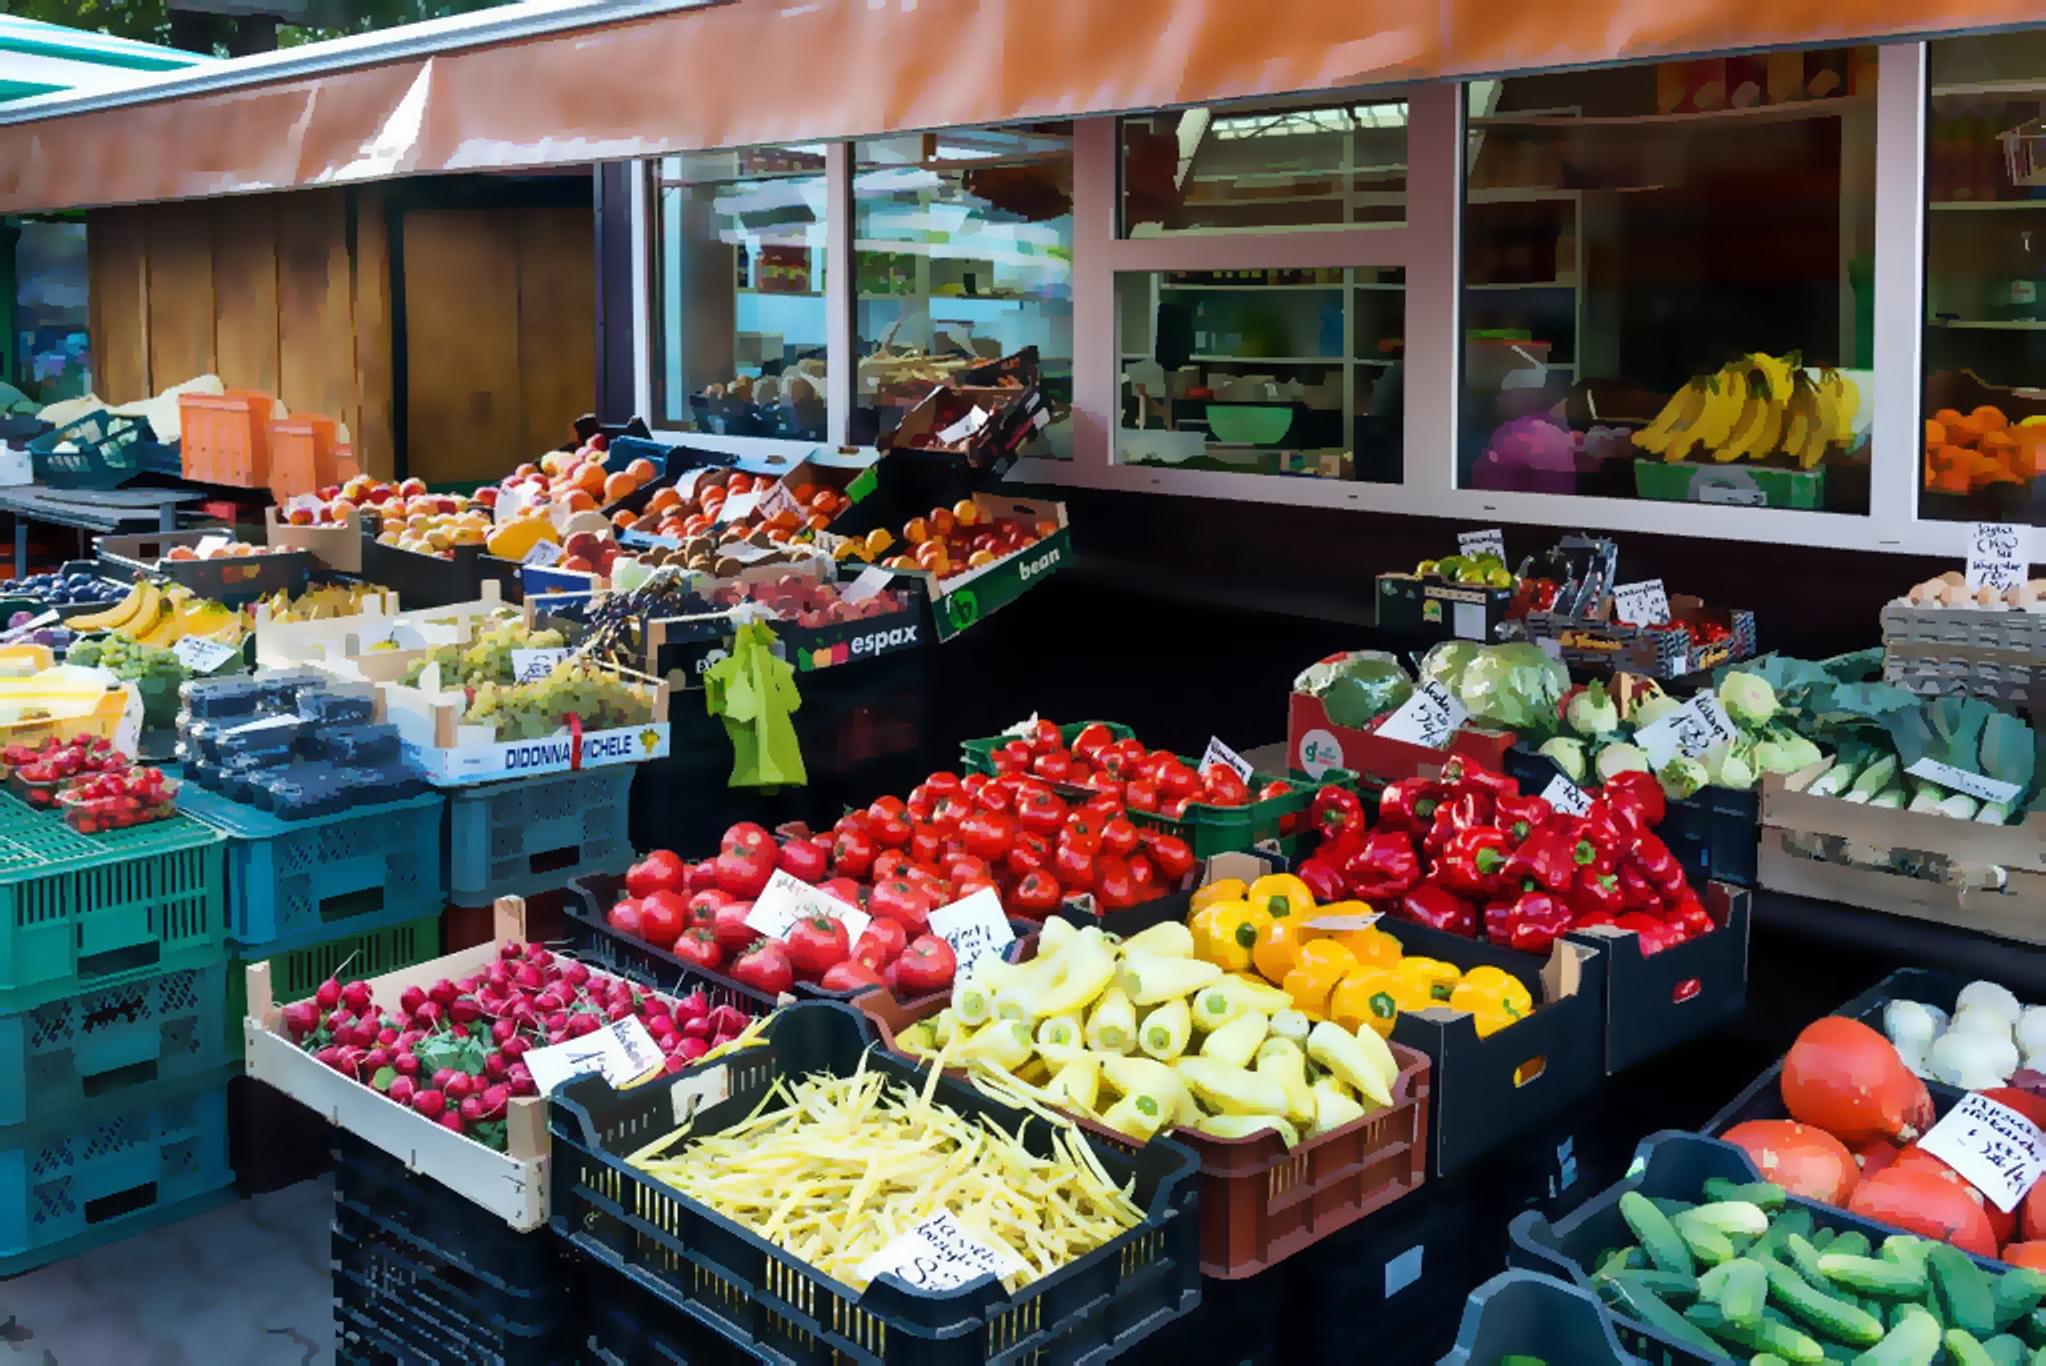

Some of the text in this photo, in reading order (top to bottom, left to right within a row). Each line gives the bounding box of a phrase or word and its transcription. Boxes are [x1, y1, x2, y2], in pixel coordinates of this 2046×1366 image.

[1019, 549, 1060, 580] bean
[851, 625, 918, 656] espax
[505, 741, 571, 769] DIDONNA
